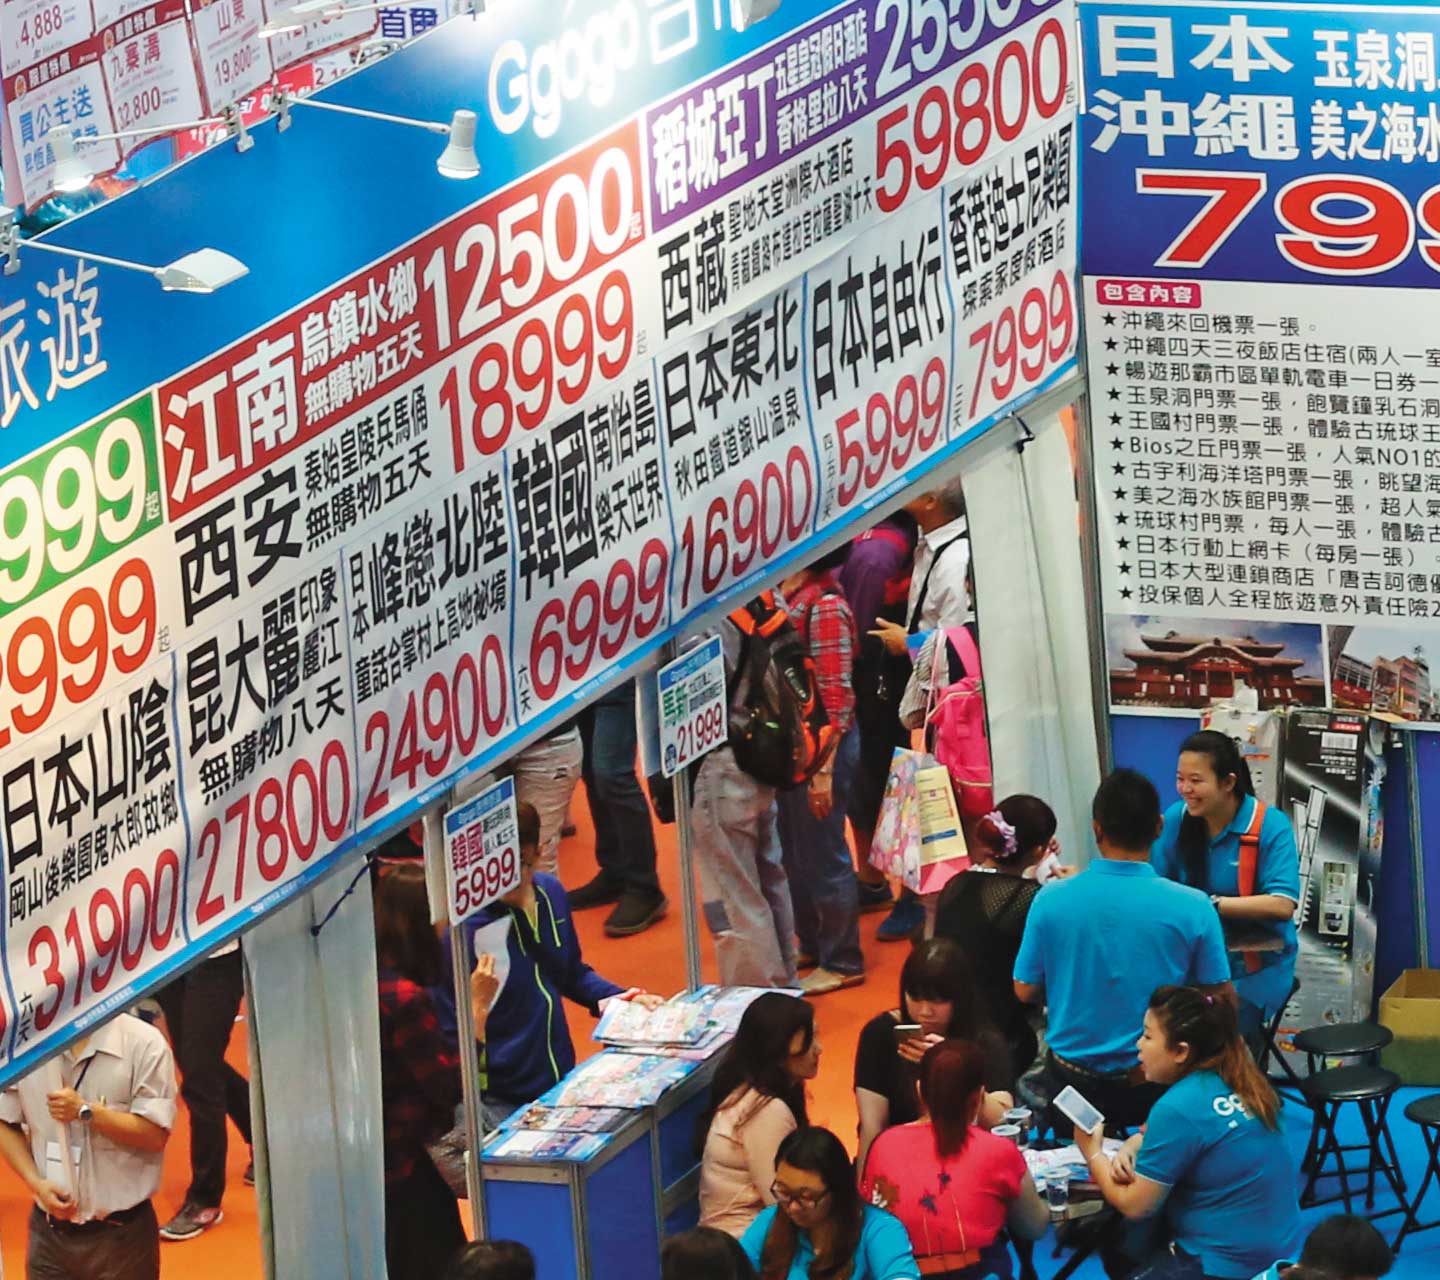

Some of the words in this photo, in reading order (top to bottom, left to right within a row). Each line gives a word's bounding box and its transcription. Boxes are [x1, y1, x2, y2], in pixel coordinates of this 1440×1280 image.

[875, 17, 1069, 215] 59800
[1088, 89, 1300, 161] 沖繩
[1097, 14, 1294, 83] 日本
[652, 60, 775, 217] 稻城亞丁
[423, 145, 634, 353] 12500
[813, 223, 947, 411] 日本自由行
[165, 330, 298, 506] 江南
[438, 269, 635, 474] 18999
[662, 287, 800, 450] 日本東北
[968, 268, 1074, 420] 7999
[511, 410, 598, 603] 韓國
[836, 355, 947, 508] 5999
[174, 464, 303, 629] 西安
[680, 443, 814, 610] 16900
[529, 535, 670, 702] 6999
[3, 676, 172, 876] 日本山陰
[199, 674, 347, 805] 無購物八天
[363, 632, 508, 820] 24900
[195, 738, 352, 928] 27800
[451, 819, 485, 873] 韓國
[455, 846, 517, 918] 5999
[27, 847, 180, 1033] 31900
